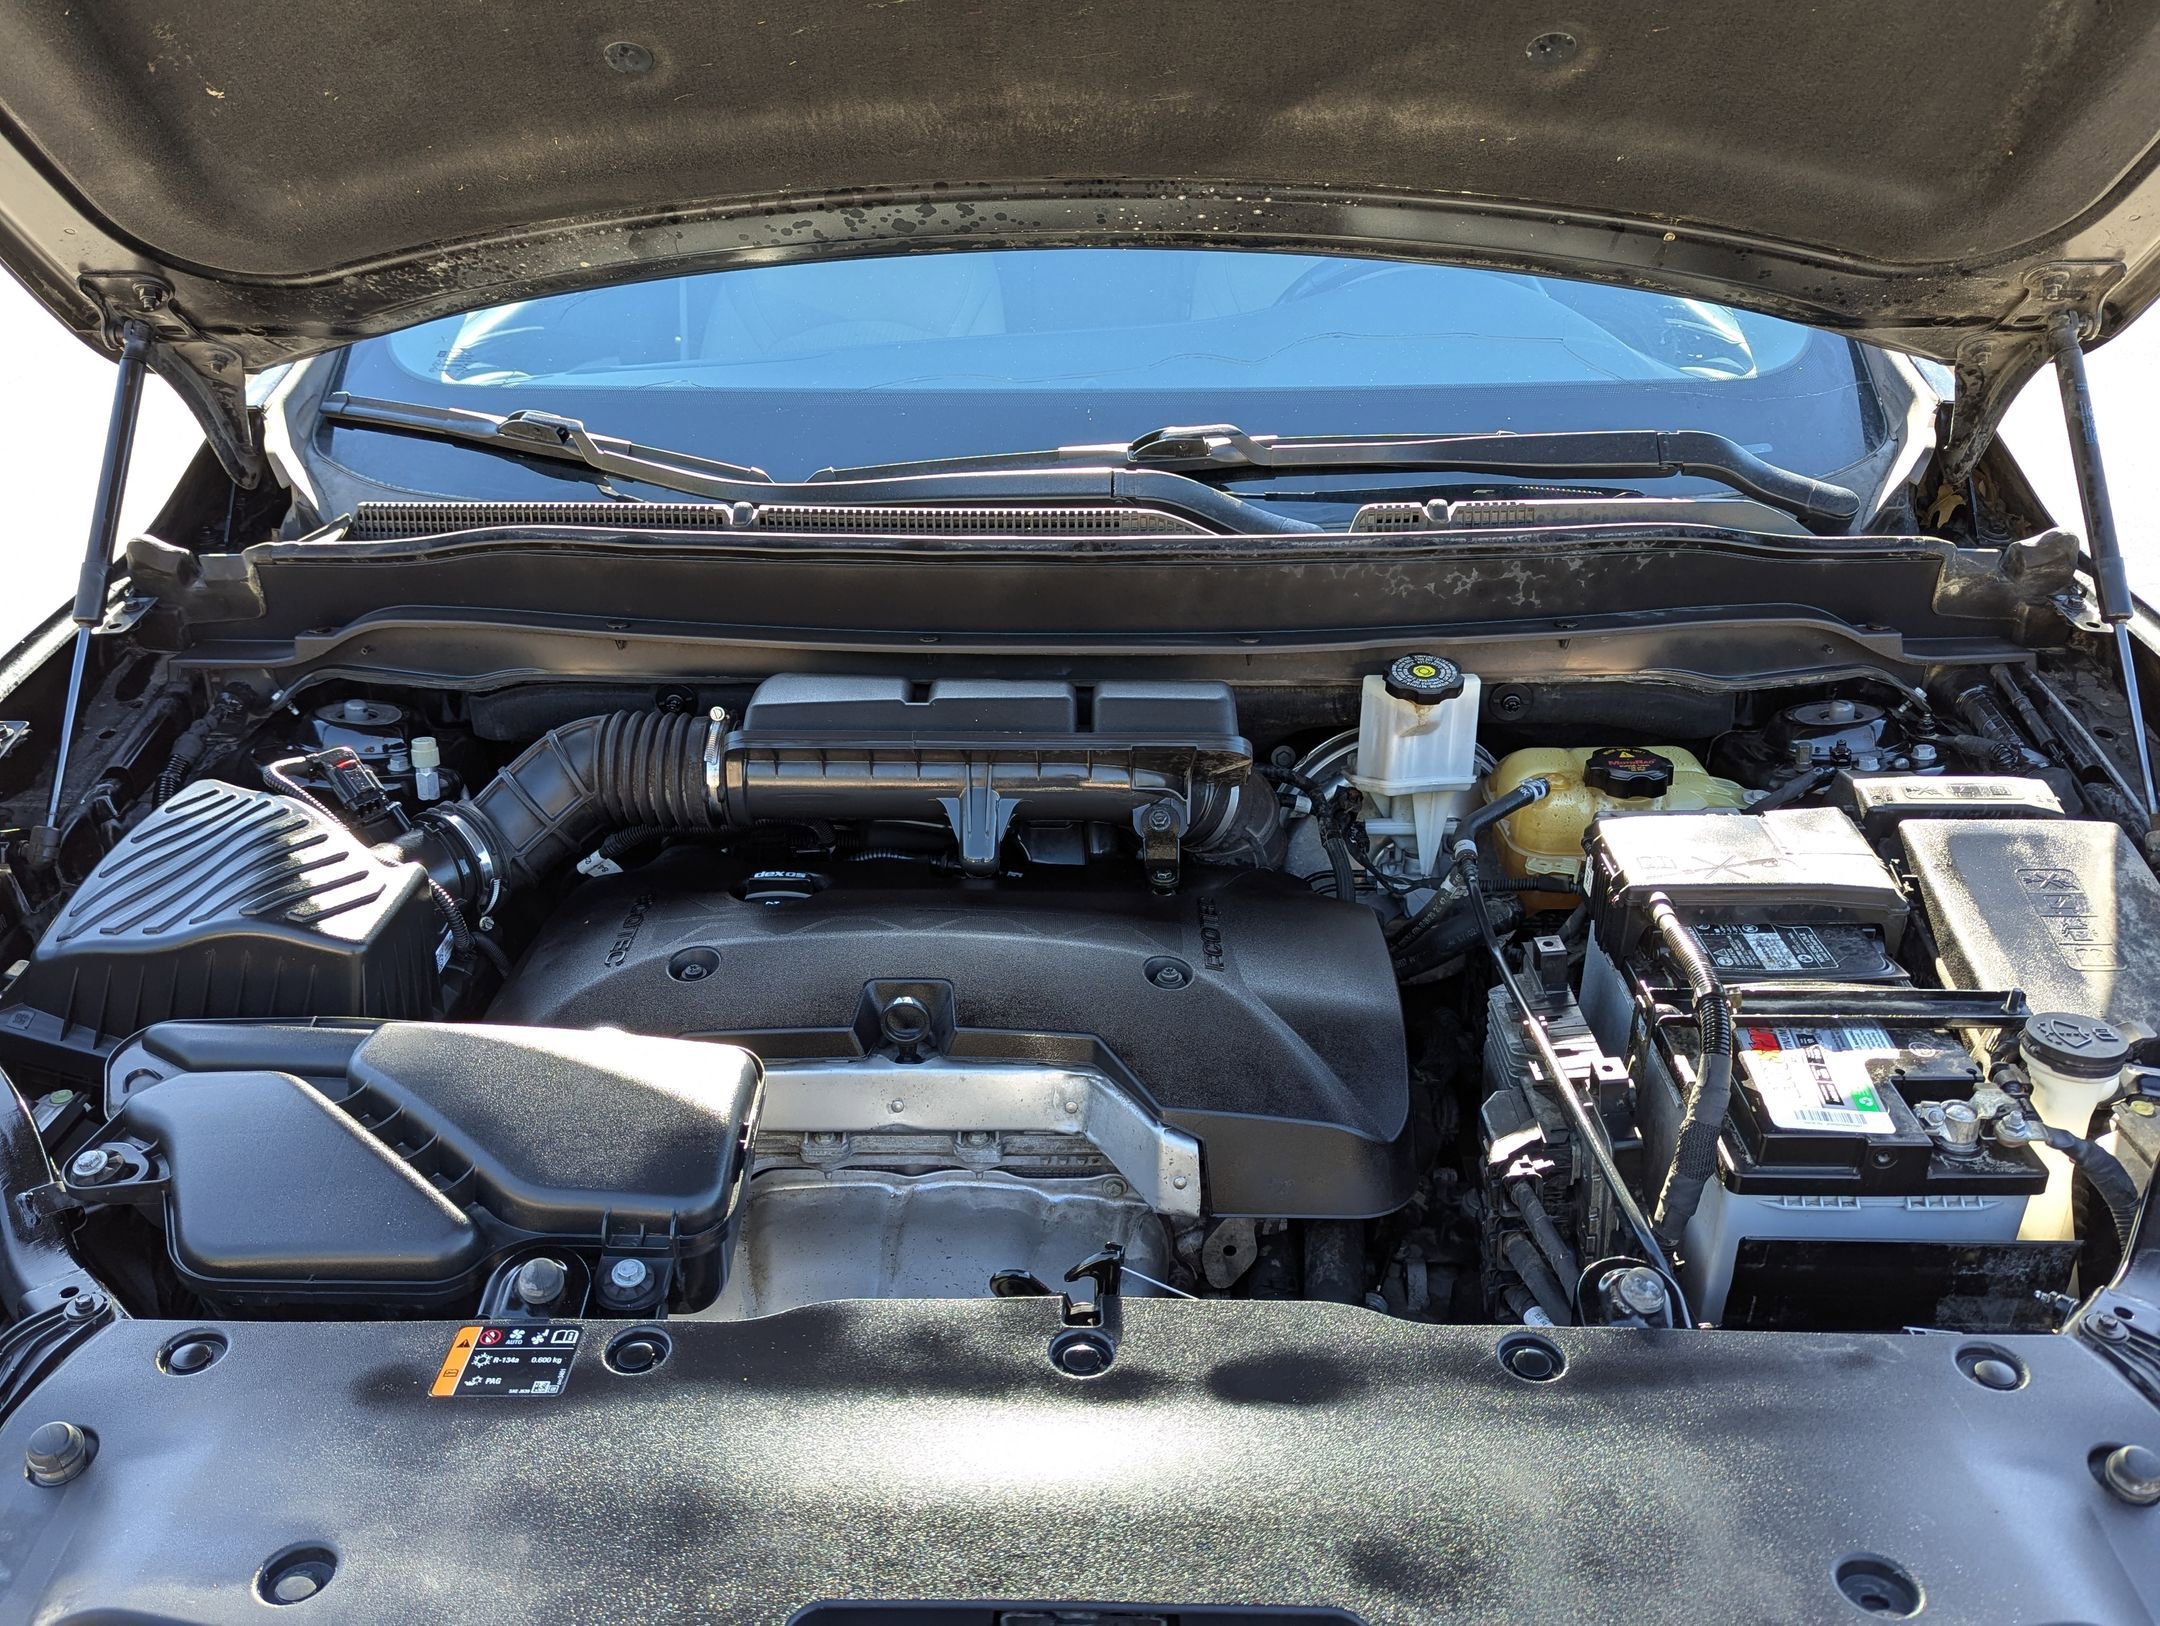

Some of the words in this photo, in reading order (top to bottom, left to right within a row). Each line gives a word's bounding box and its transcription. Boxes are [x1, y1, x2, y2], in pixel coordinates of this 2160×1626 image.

[754, 871, 806, 879] dexos
[493, 1356, 520, 1364] R-134a
[552, 1356, 563, 1365] kg
[485, 1377, 502, 1385] PAG
